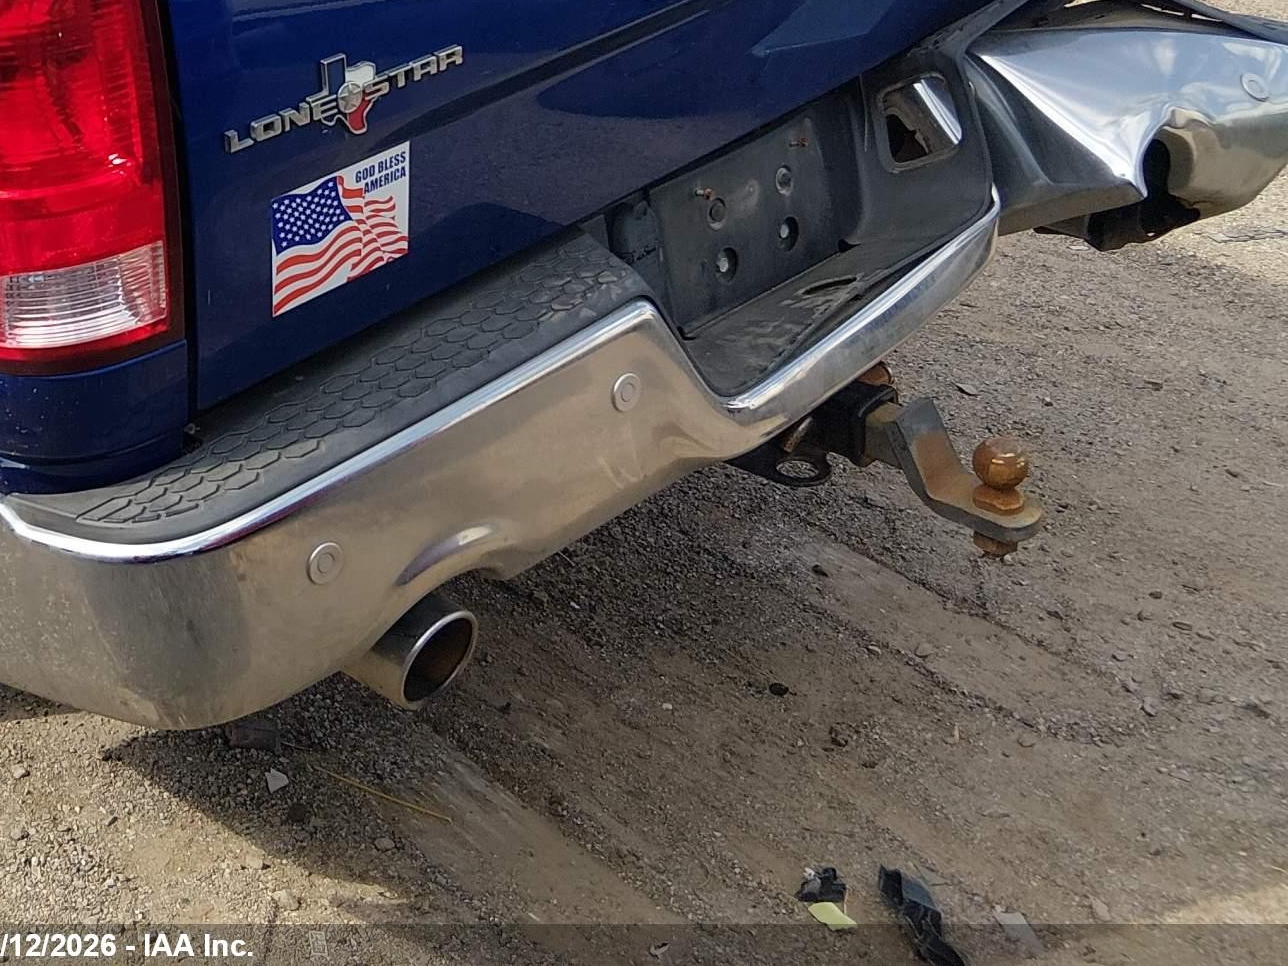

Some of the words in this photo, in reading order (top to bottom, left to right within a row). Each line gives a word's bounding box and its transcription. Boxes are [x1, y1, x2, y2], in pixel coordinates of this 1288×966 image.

[224, 93, 339, 155] LONE
[362, 44, 463, 101] STAR
[355, 164, 376, 184] GOD
[378, 151, 406, 175] BLESS
[364, 166, 406, 195] AMERICA
